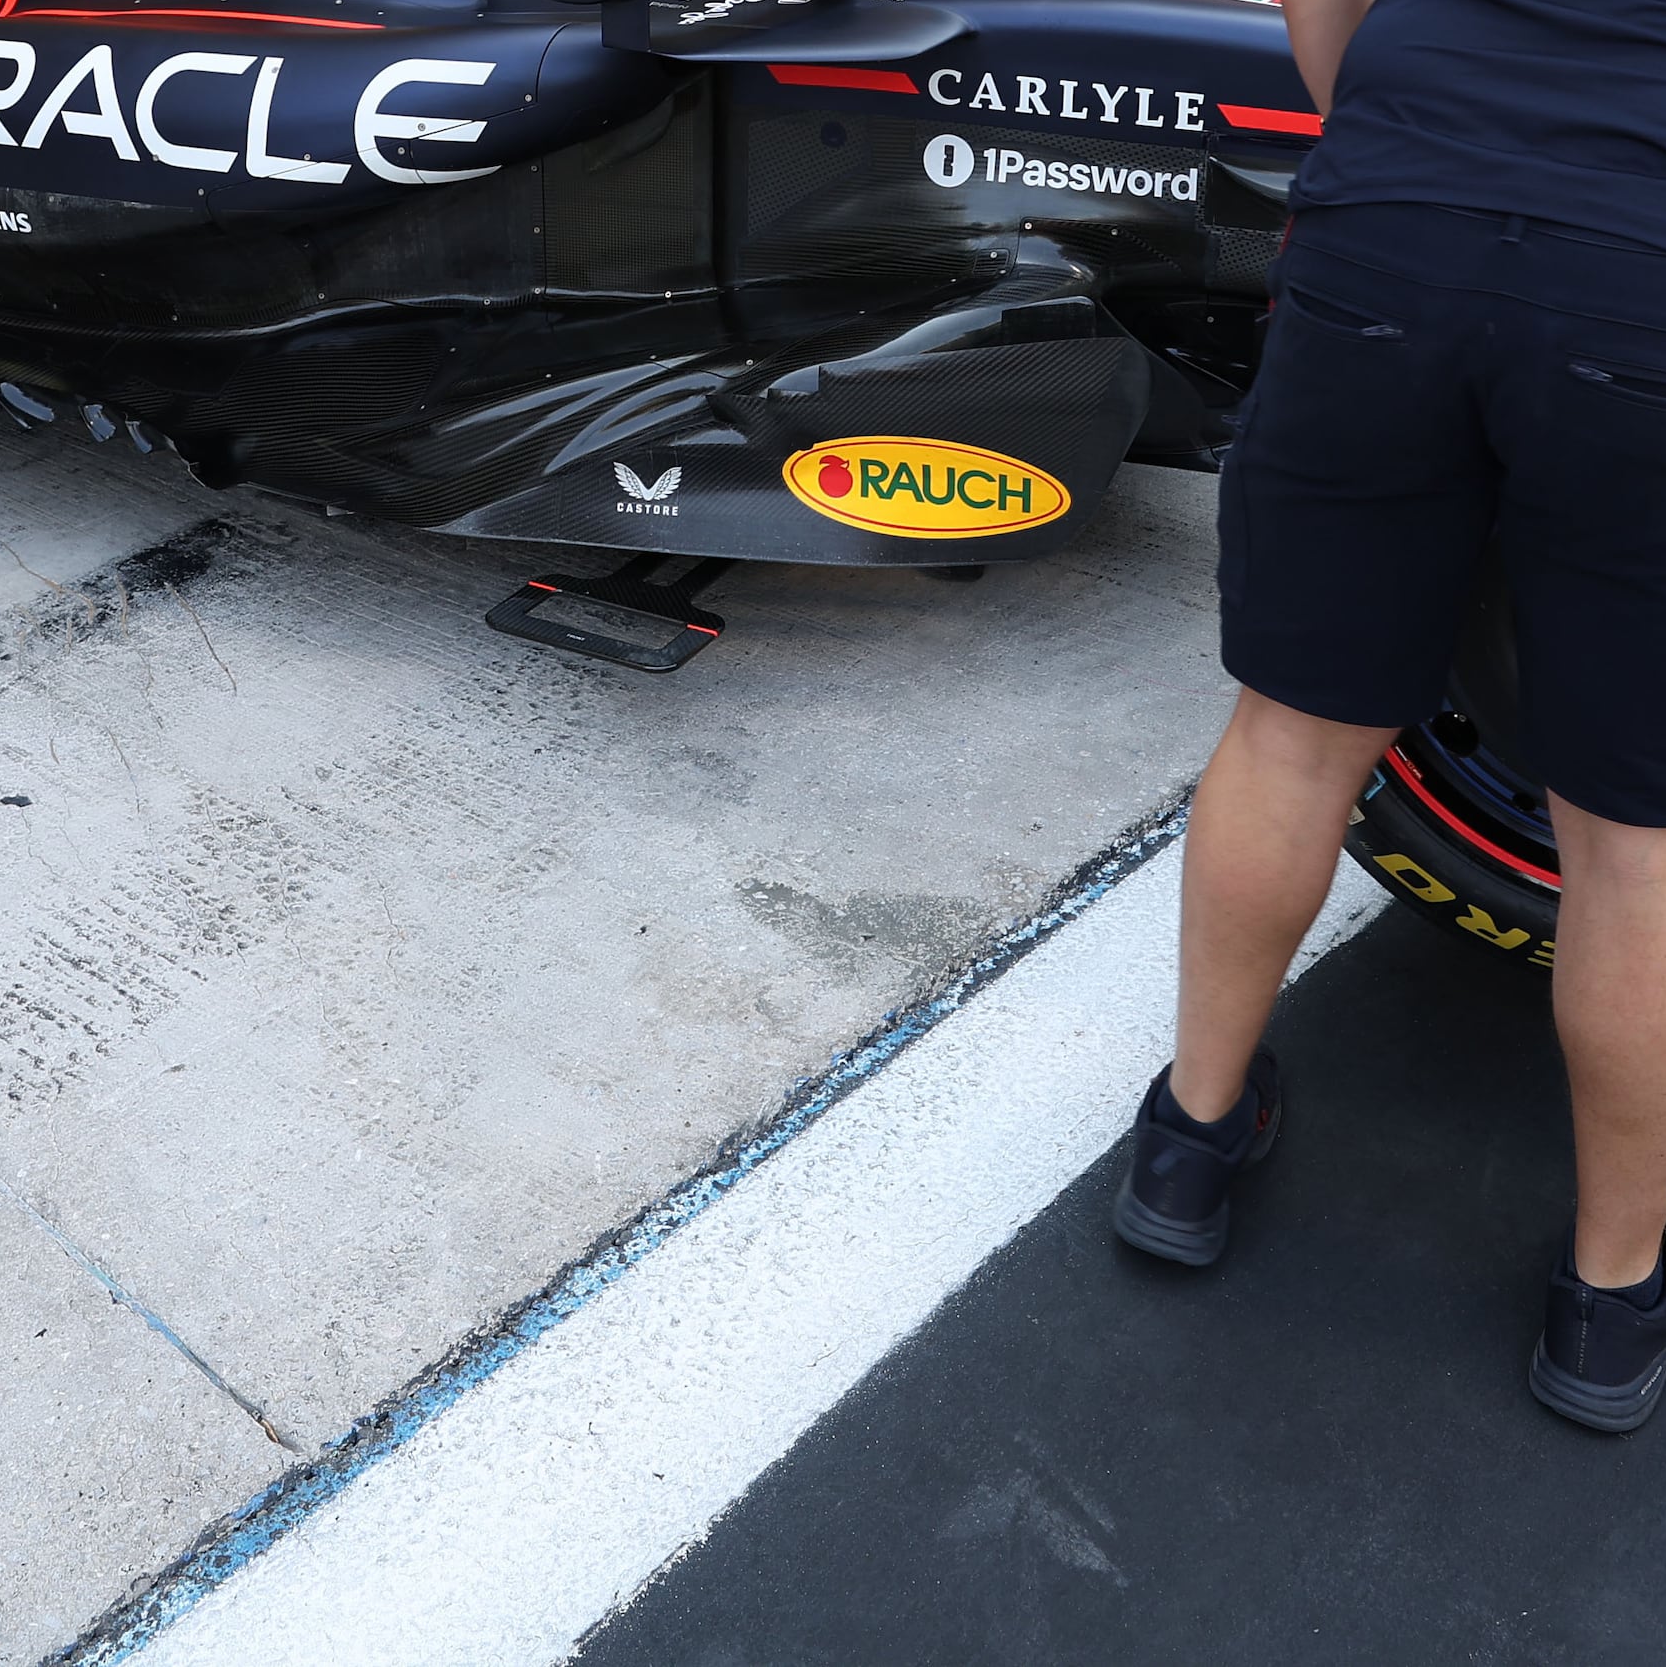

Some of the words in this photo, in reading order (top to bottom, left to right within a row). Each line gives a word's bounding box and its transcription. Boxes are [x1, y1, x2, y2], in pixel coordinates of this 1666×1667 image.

[929, 69, 1205, 131] CARLYLE
[985, 149, 1198, 201] 1Password
[616, 502, 680, 518] CASTORE
[858, 458, 1032, 514] RAUCH
